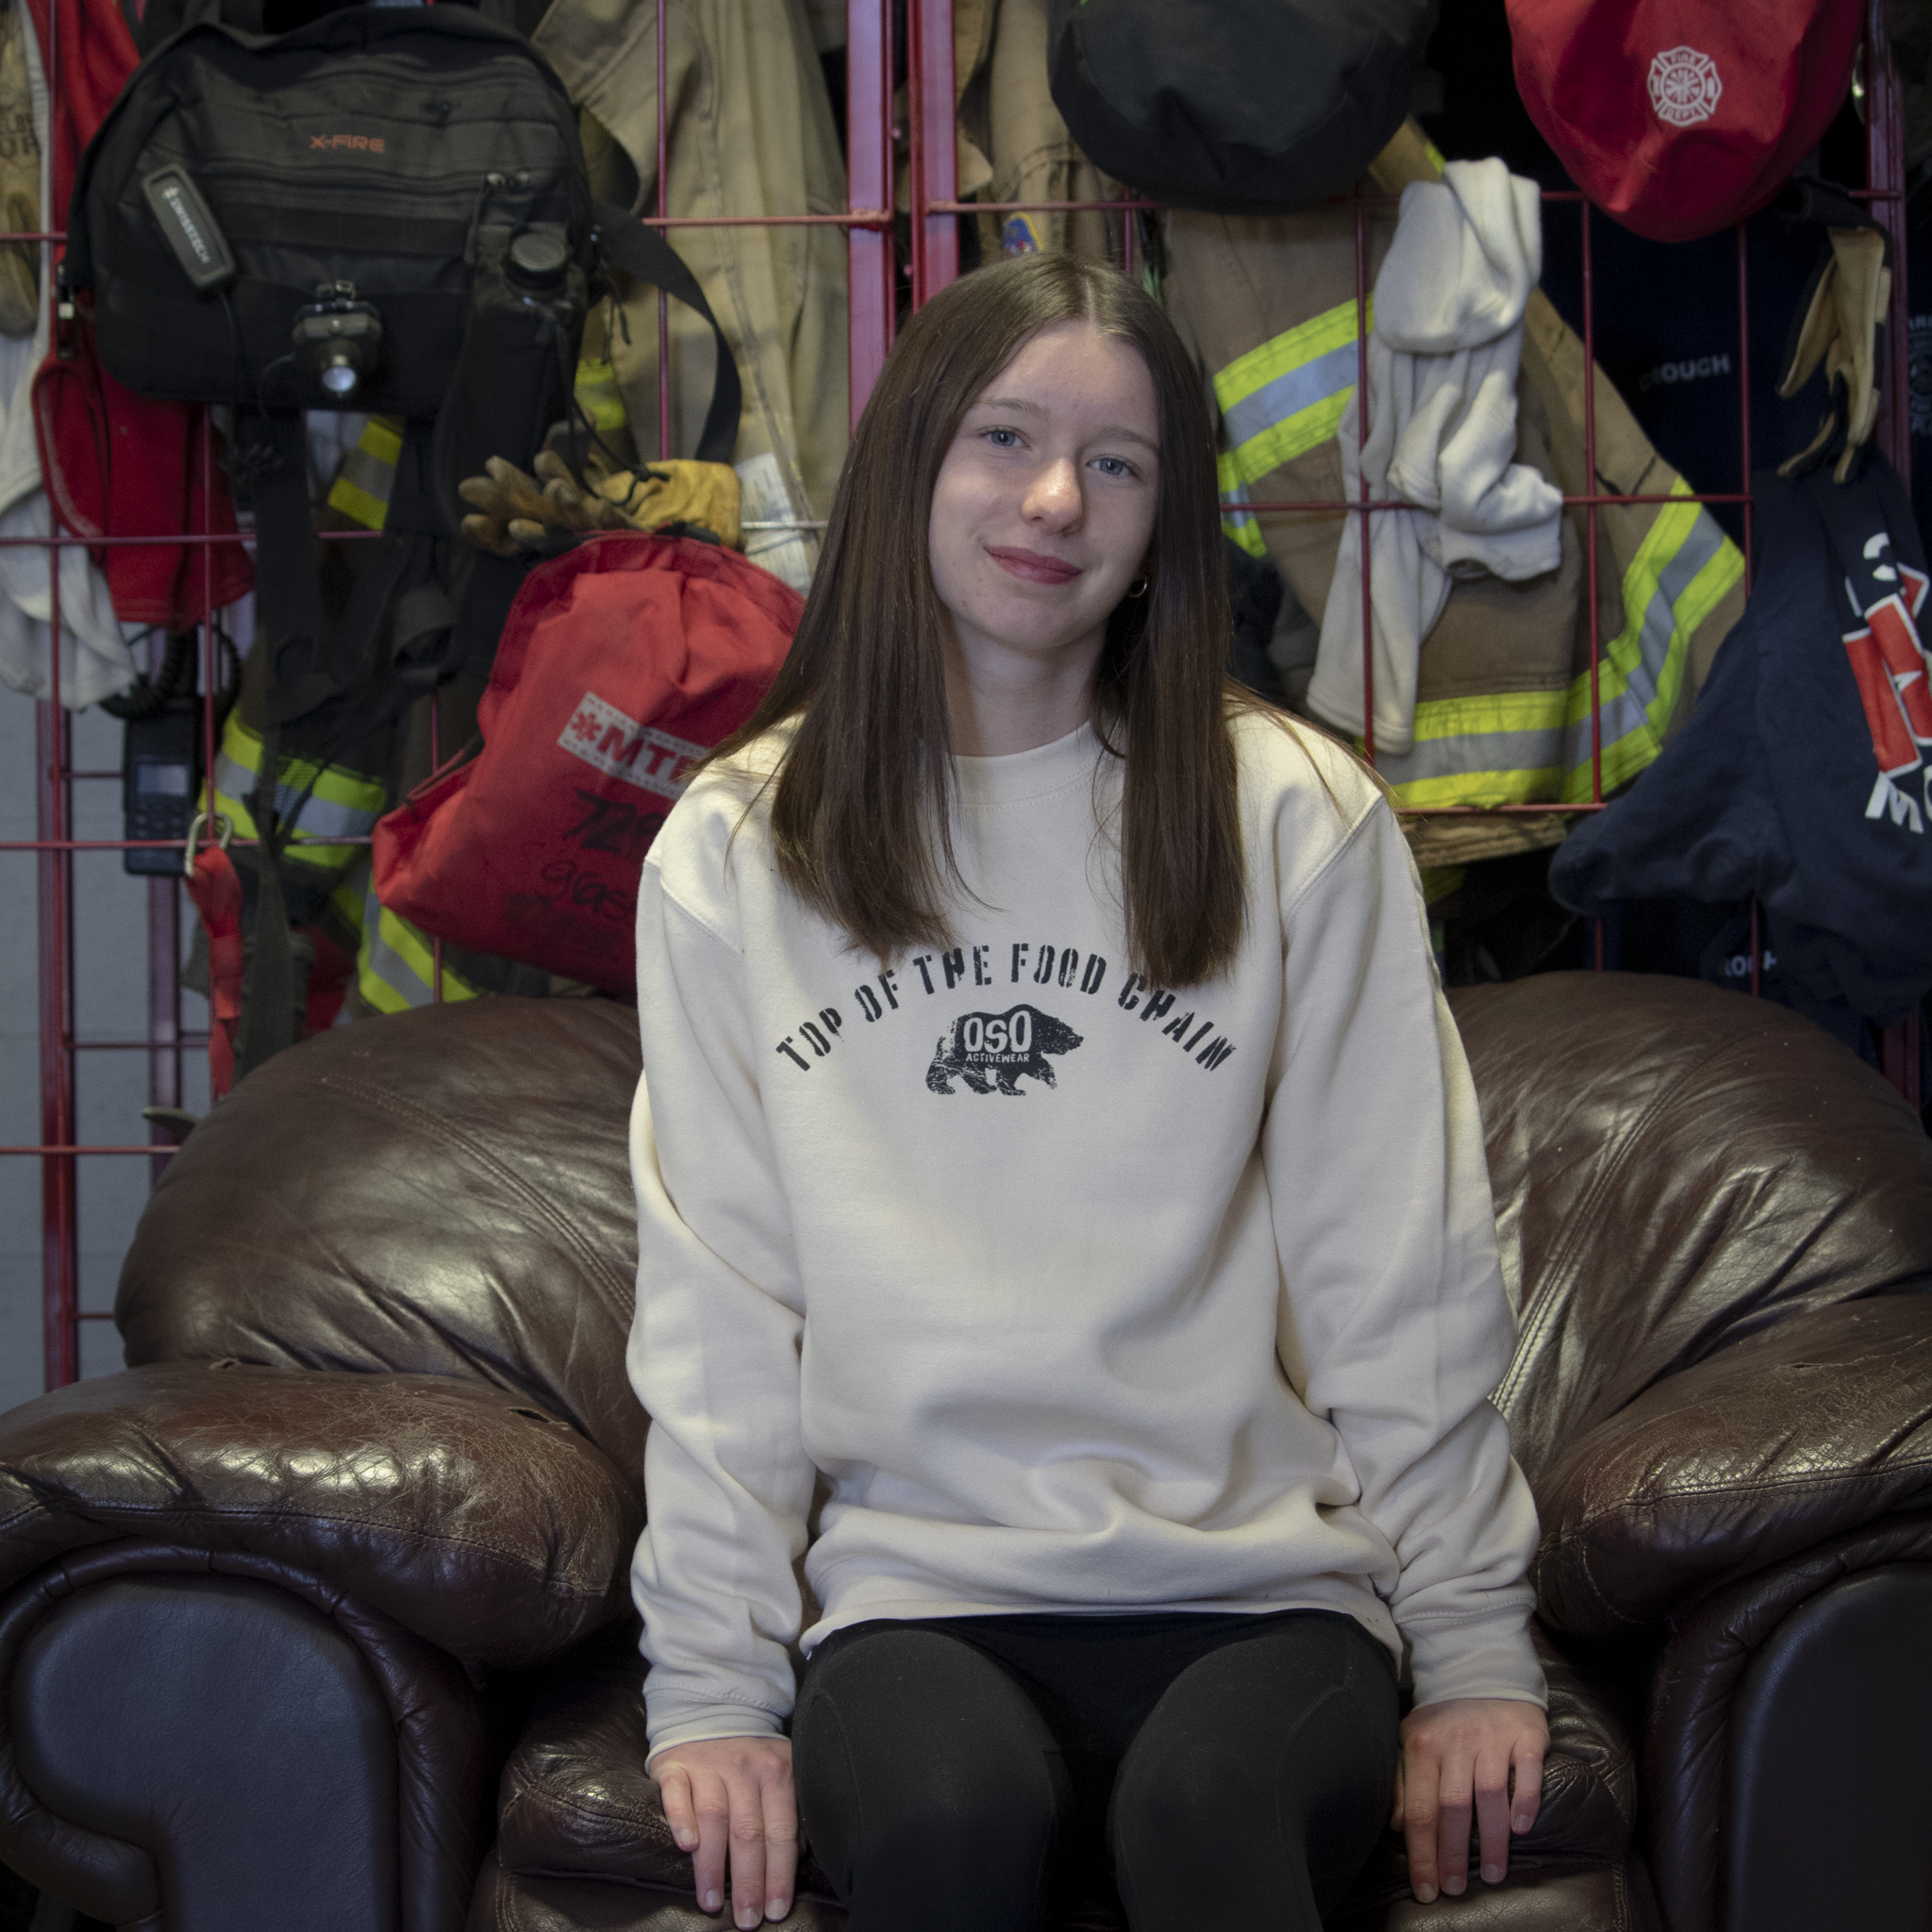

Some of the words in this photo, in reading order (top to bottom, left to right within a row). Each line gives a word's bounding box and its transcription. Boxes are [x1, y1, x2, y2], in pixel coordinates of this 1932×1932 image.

[308, 134, 386, 154] X-FIRE
[775, 1007, 843, 1072] TOP
[854, 969, 899, 1023] OF
[912, 944, 992, 995] THE
[1010, 942, 1108, 995] FOOD
[1117, 972, 1237, 1072] CHAIN
[963, 1009, 1033, 1054] OSO
[965, 1053, 1030, 1063] ACTIVEWEAR
